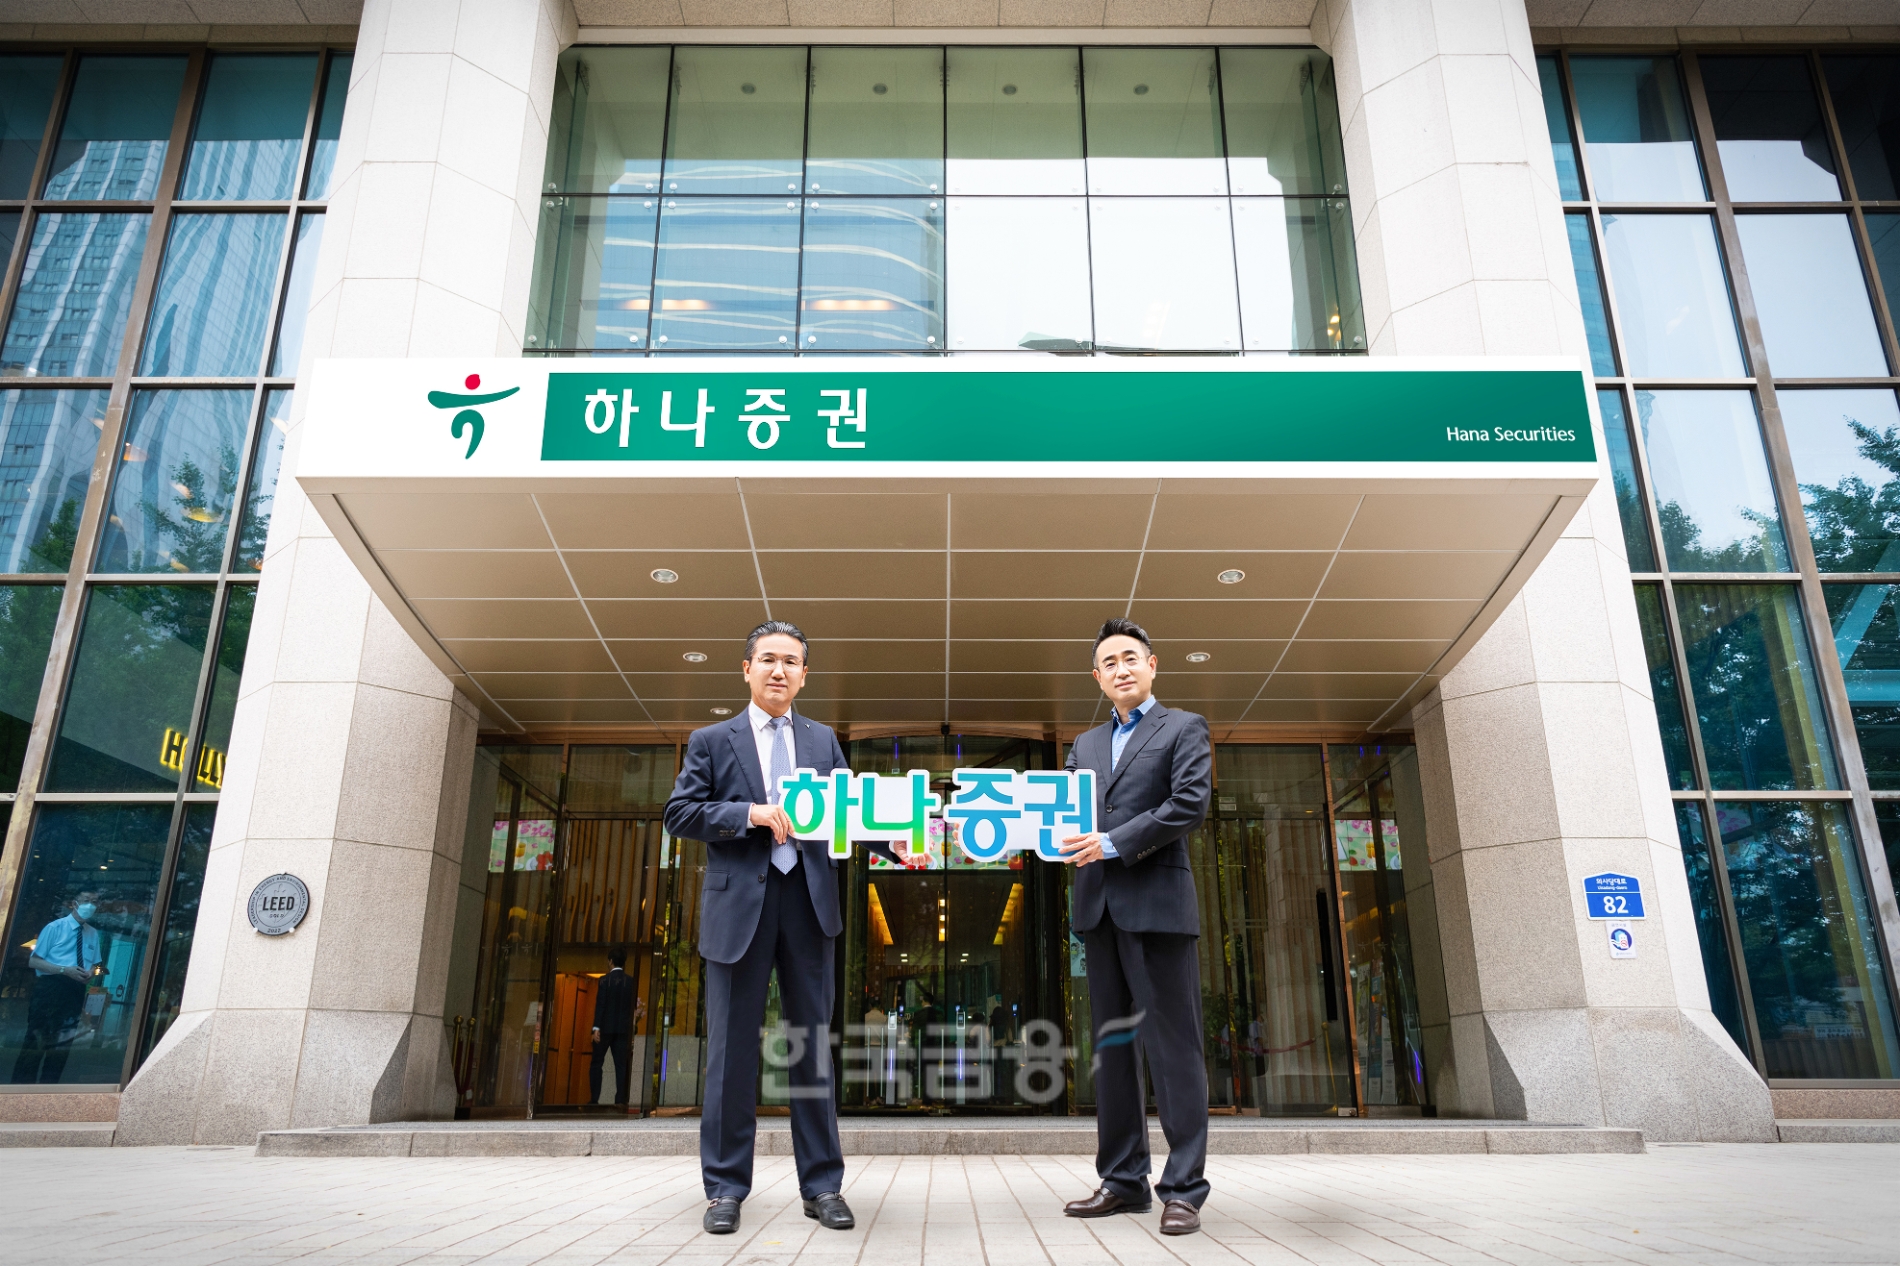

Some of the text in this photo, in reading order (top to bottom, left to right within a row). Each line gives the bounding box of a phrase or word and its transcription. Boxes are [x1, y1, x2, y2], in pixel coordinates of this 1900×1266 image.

[584, 387, 868, 450] 하나증권
[1446, 426, 1576, 442] Hana Securities
[262, 896, 295, 911] LEED
[1603, 895, 1629, 914] 82
